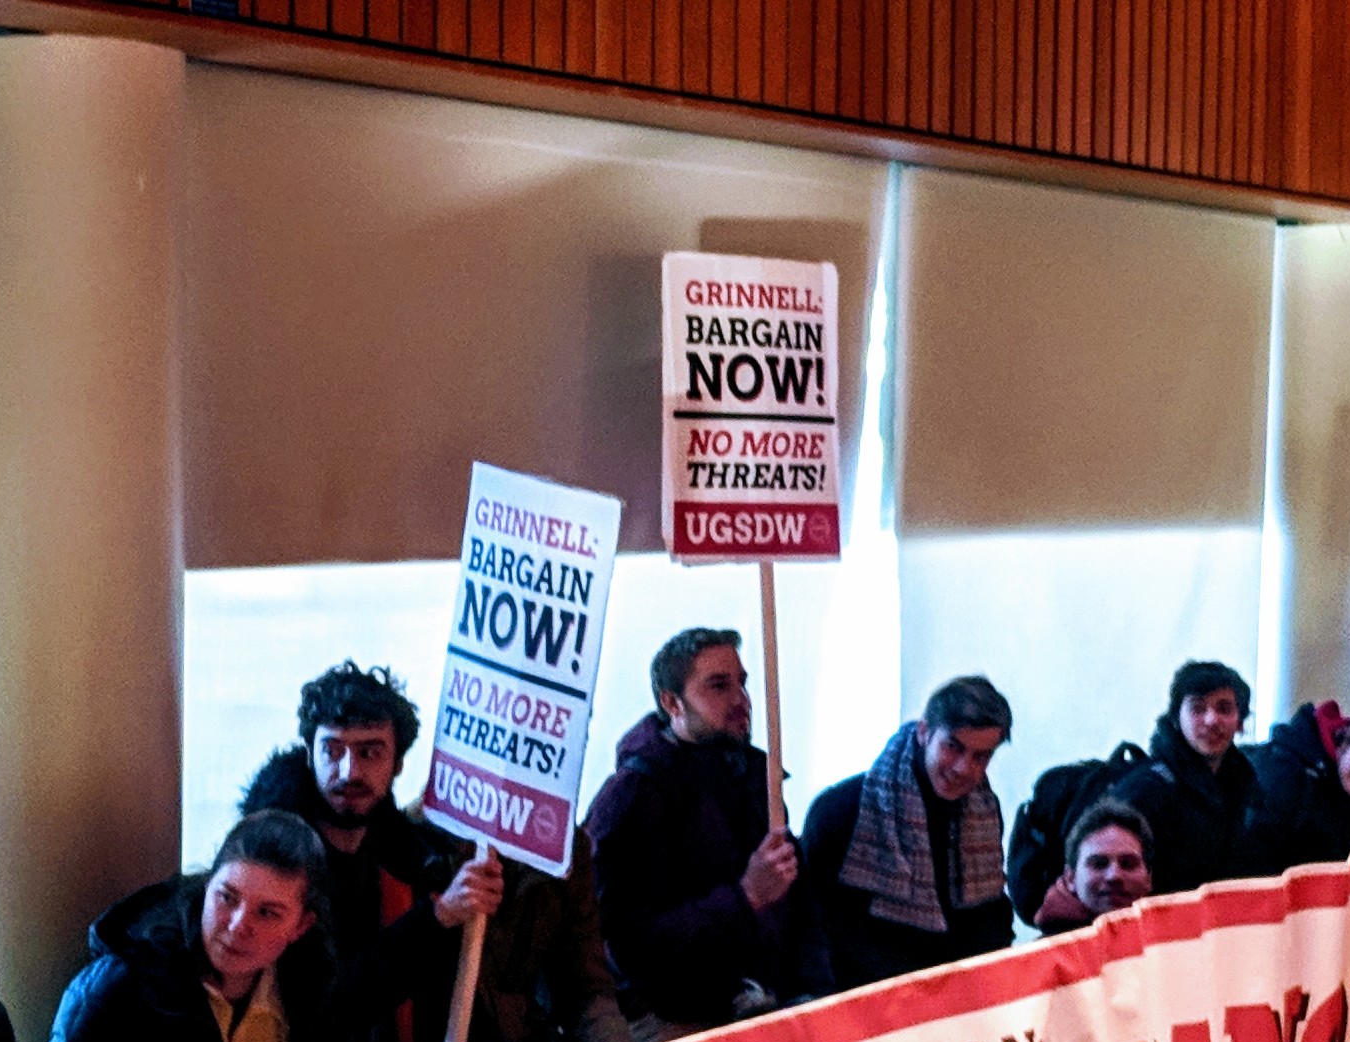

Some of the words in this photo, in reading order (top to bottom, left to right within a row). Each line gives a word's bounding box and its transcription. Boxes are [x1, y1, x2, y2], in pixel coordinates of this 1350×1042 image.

[685, 279, 823, 315] GRINNELL:
[686, 315, 823, 352] BARGAIN
[686, 351, 825, 406] NOW!
[687, 429, 732, 457] NO
[740, 430, 825, 459] MORE
[687, 461, 826, 491] THREATS!
[475, 497, 599, 559] GRINNELL:
[685, 512, 806, 545] UGSDW
[468, 536, 593, 607] BARGAIN
[458, 578, 588, 675] NOW!
[448, 668, 482, 707] NO
[485, 682, 572, 739] MORE
[444, 705, 566, 778] THREATS!
[435, 761, 534, 835] UGSDW
